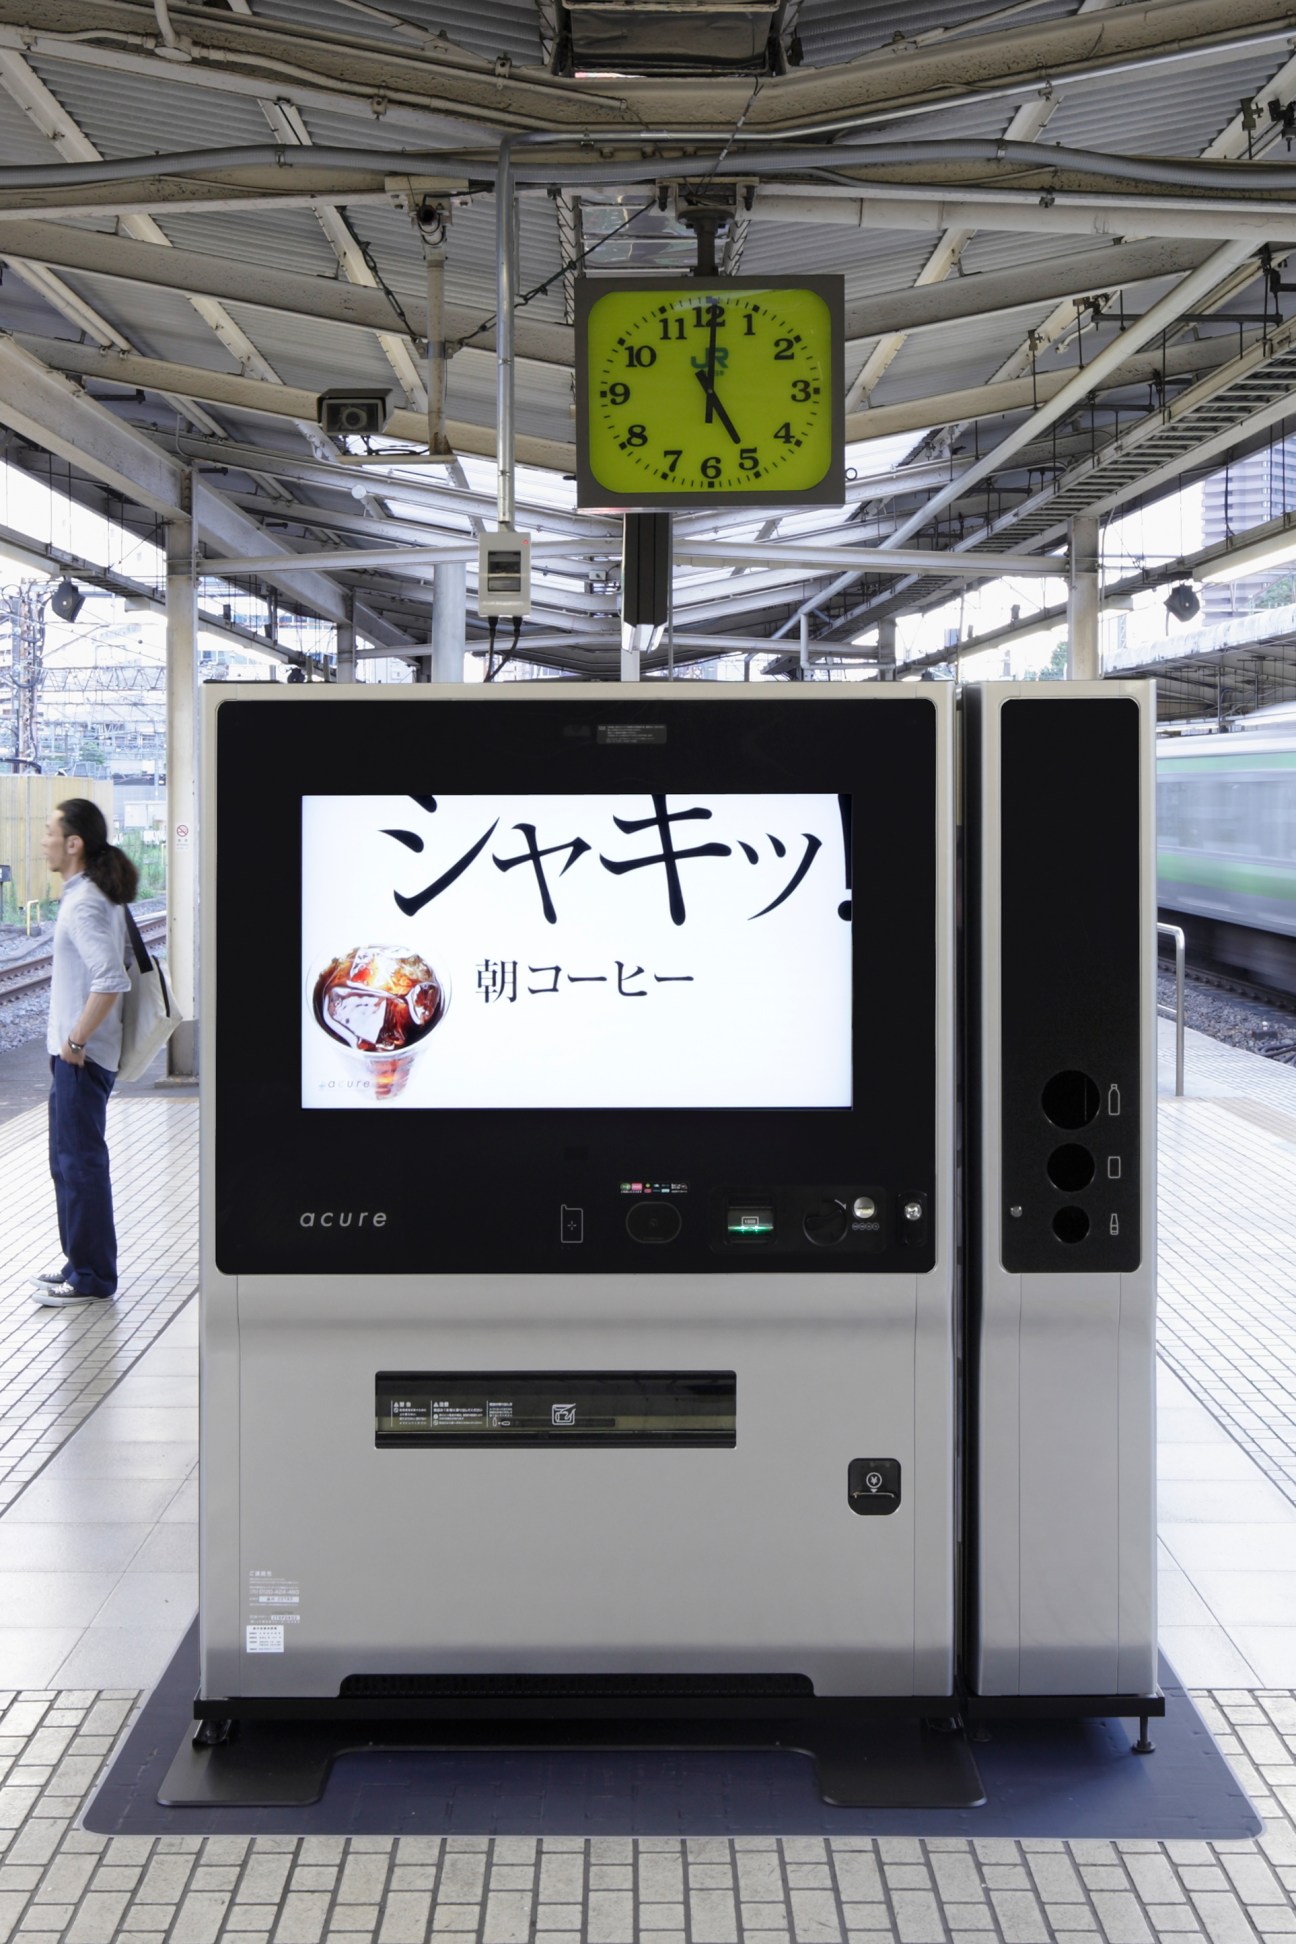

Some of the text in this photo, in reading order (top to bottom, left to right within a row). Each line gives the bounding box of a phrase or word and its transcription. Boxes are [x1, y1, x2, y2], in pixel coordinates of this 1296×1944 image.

[692, 305, 726, 328] 12
[743, 313, 756, 336] 1
[659, 318, 687, 340] 11
[624, 345, 657, 368] 10
[691, 347, 729, 369] JR
[774, 338, 795, 361] 2
[609, 382, 631, 406] 9
[791, 379, 812, 402] 3
[626, 424, 648, 447] 8
[773, 422, 796, 444] 4
[663, 450, 683, 473] 7
[700, 456, 722, 479] 6
[738, 447, 760, 471] 5
[475, 958, 695, 1003] 朝コーヒー
[299, 1212, 387, 1227] acure
